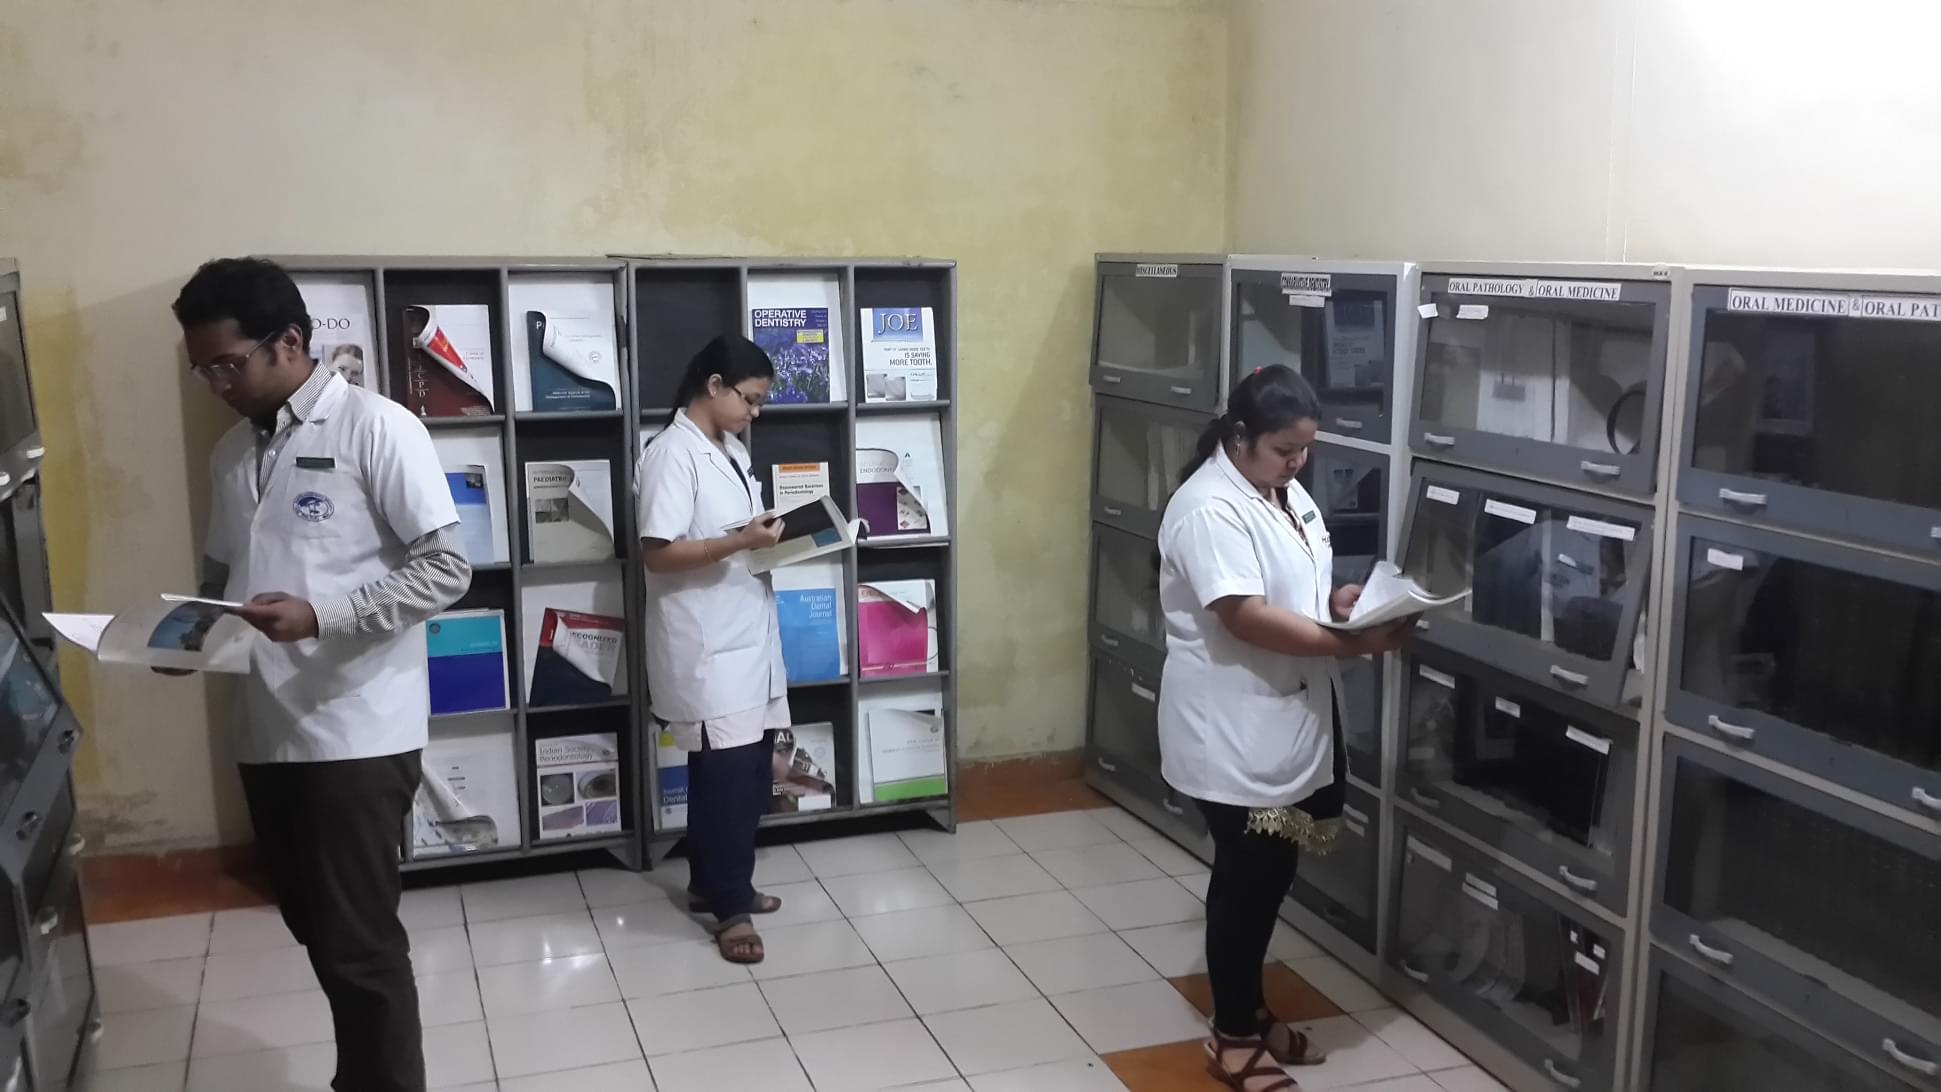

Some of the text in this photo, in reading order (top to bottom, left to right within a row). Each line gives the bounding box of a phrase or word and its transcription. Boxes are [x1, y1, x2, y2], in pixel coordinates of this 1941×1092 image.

[1449, 281, 1535, 297] ORAL PATHOLOGY &
[1538, 284, 1619, 300] ORAL MEDICINE
[1732, 295, 1769, 311] ORAL
[1774, 296, 1847, 314] MEDICINE
[1864, 300, 1906, 317] ORAL
[754, 309, 807, 319] OPERATIVE
[754, 319, 807, 327] DENTISTRY
[877, 313, 919, 335] JOE
[911, 351, 931, 359] SAVING
[889, 359, 908, 367] MORE
[799, 593, 832, 602] Australian
[811, 601, 832, 610] Dental
[808, 609, 832, 619] Journal
